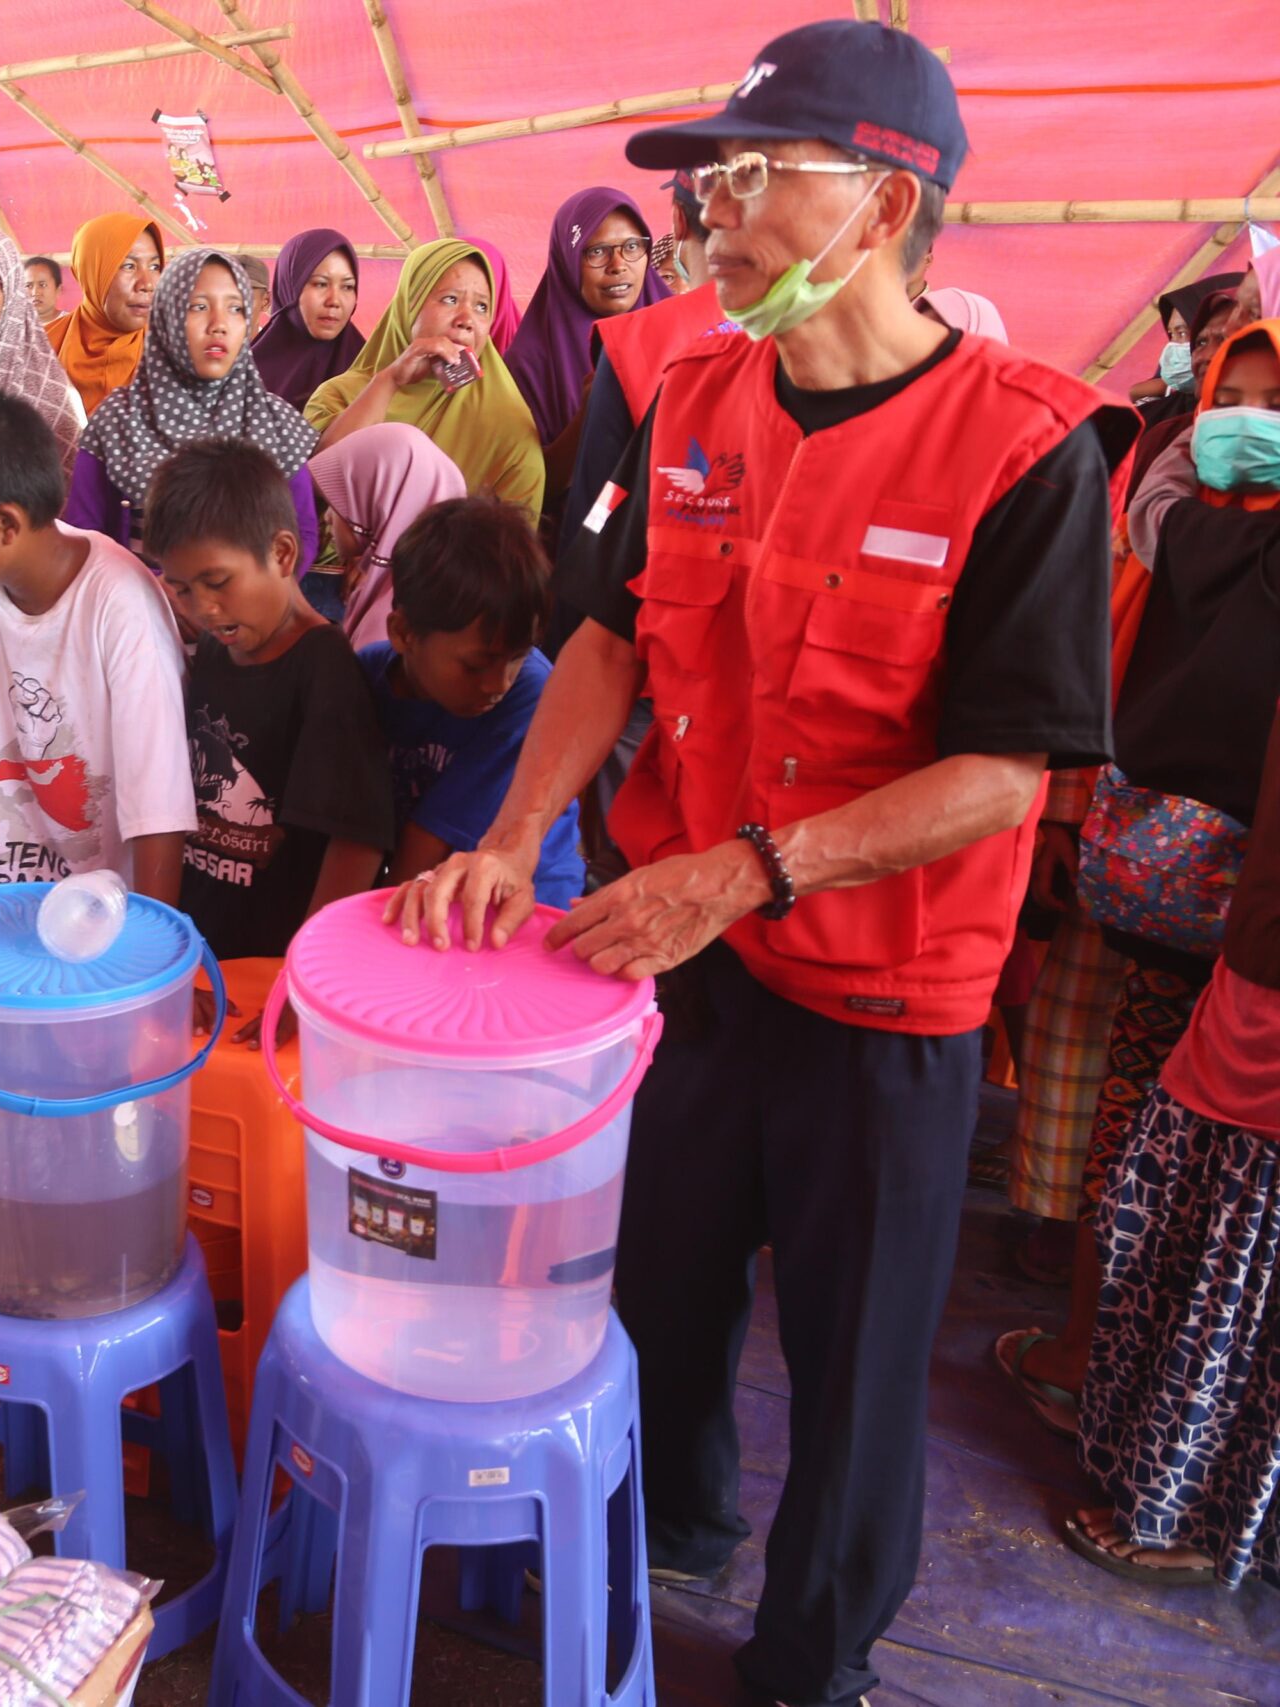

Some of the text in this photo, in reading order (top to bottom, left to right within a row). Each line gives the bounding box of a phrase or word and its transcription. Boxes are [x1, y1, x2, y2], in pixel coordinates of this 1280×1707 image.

[663, 490, 731, 507] SECOURS
[208, 827, 269, 852] Losari
[183, 843, 253, 887] ASSAR
